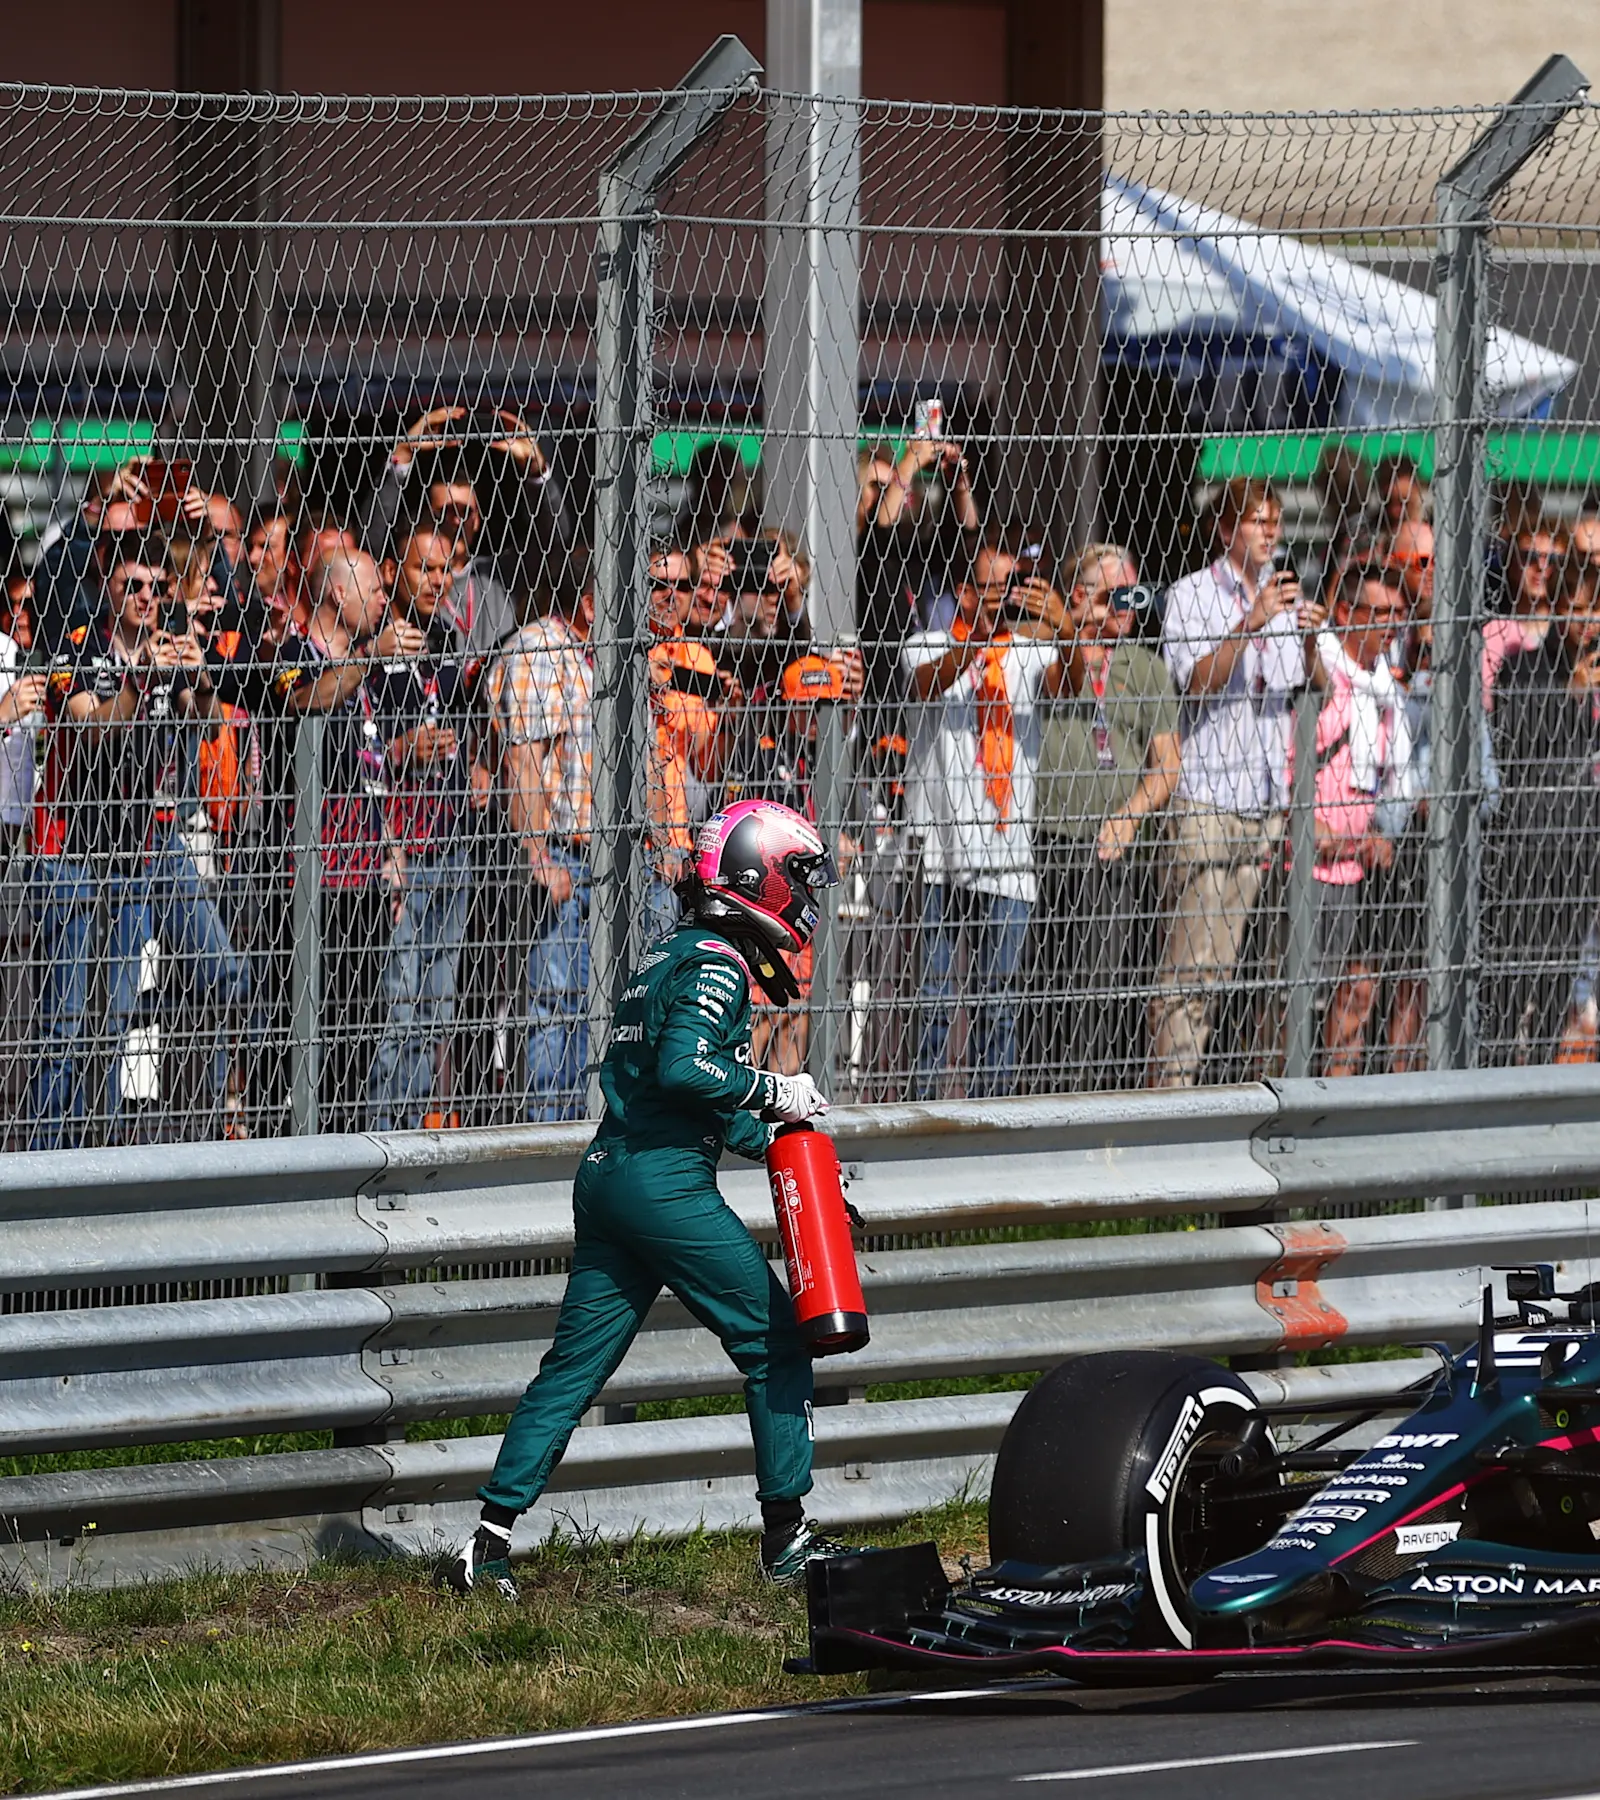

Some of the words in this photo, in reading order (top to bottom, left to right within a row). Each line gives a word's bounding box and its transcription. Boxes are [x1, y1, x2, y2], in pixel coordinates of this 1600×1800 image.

[696, 982, 734, 1003] HACKETT
[1145, 1394, 1205, 1505] PIRELLI
[1374, 1433, 1460, 1449] BWT
[1297, 1522, 1336, 1535] IFS
[1271, 1538, 1317, 1550] ERONI
[1403, 1531, 1455, 1546] RAVENOL
[1410, 1574, 1524, 1594] ASTON
[981, 1587, 1052, 1605] ASTON
[1053, 1583, 1135, 1604] MARTIN
